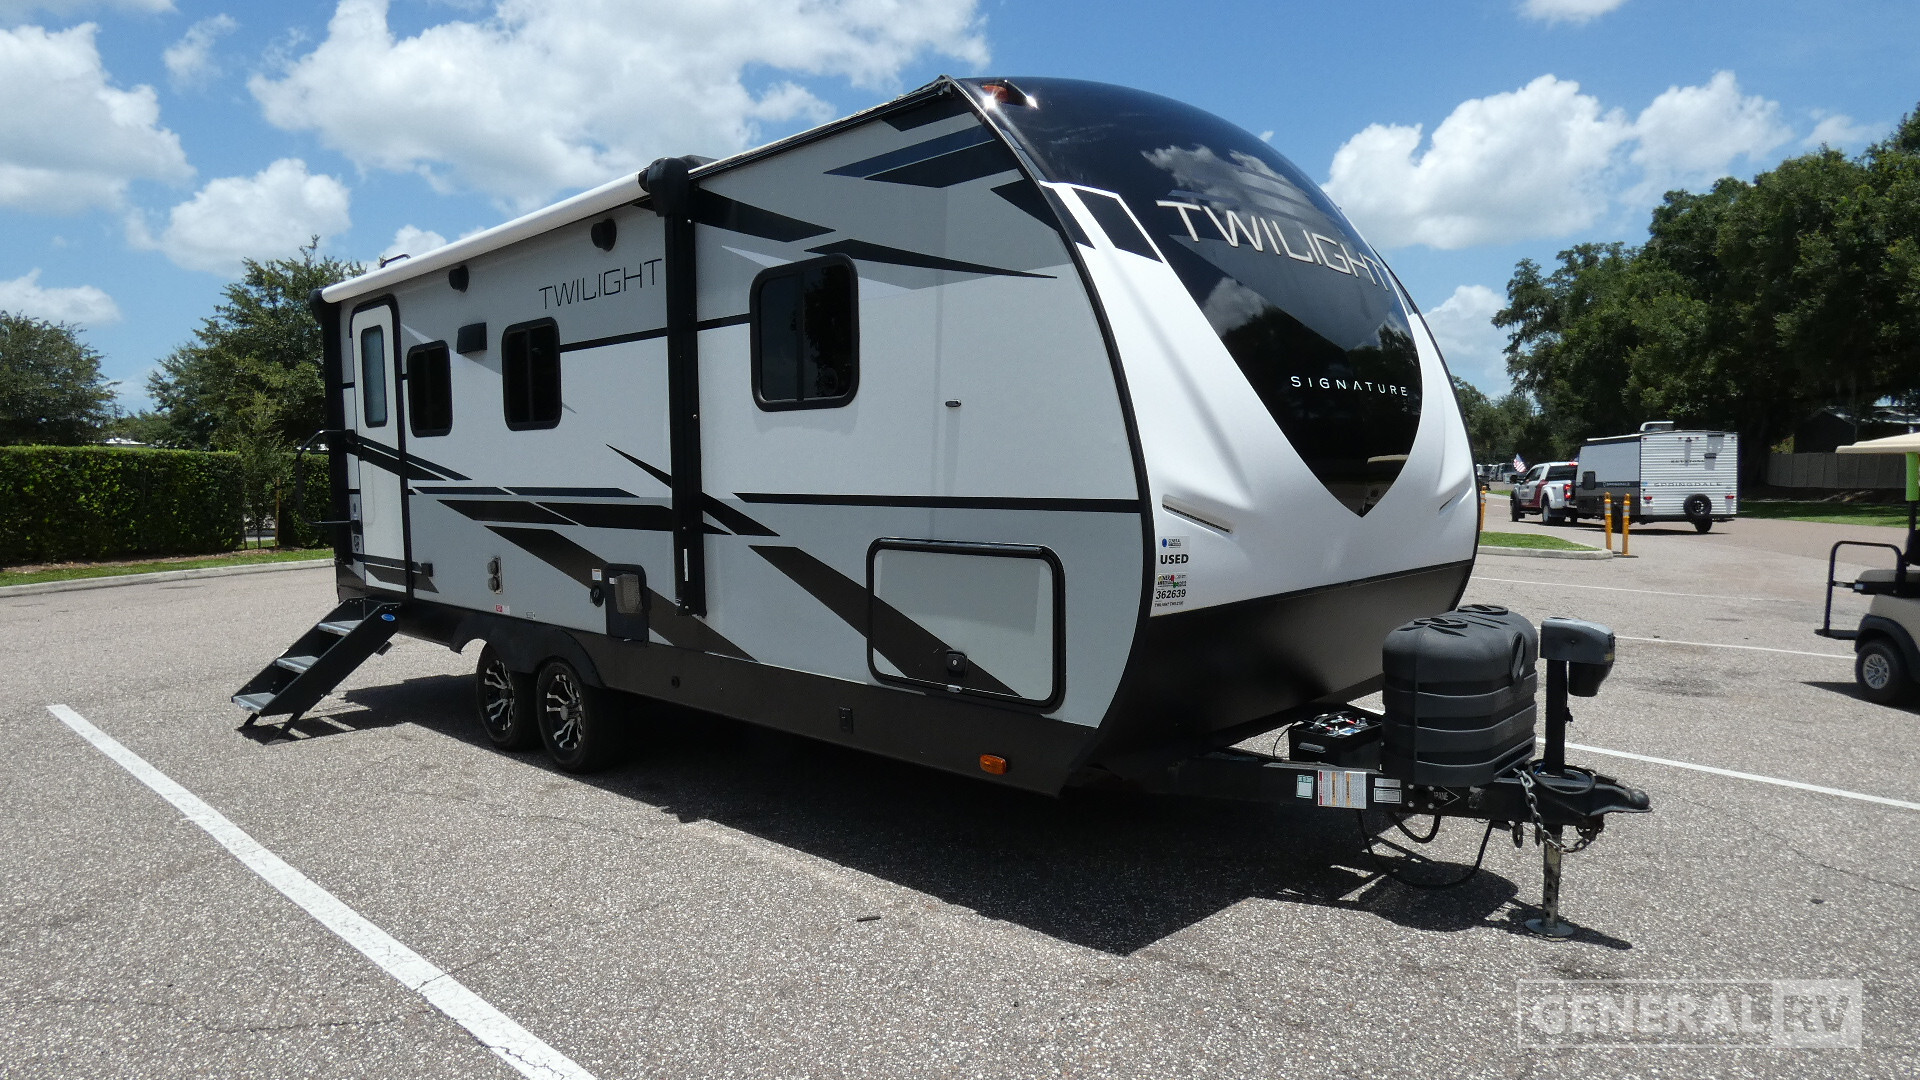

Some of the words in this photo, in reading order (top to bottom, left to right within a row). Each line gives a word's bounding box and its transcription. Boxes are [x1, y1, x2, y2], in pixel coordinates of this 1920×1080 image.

[1155, 199, 1390, 292] TWILIGHT
[538, 258, 663, 310] TWILIGHT
[1290, 375, 1409, 397] SIGNATURE
[1160, 553, 1189, 565] USED
[1155, 588, 1187, 600] 362639
